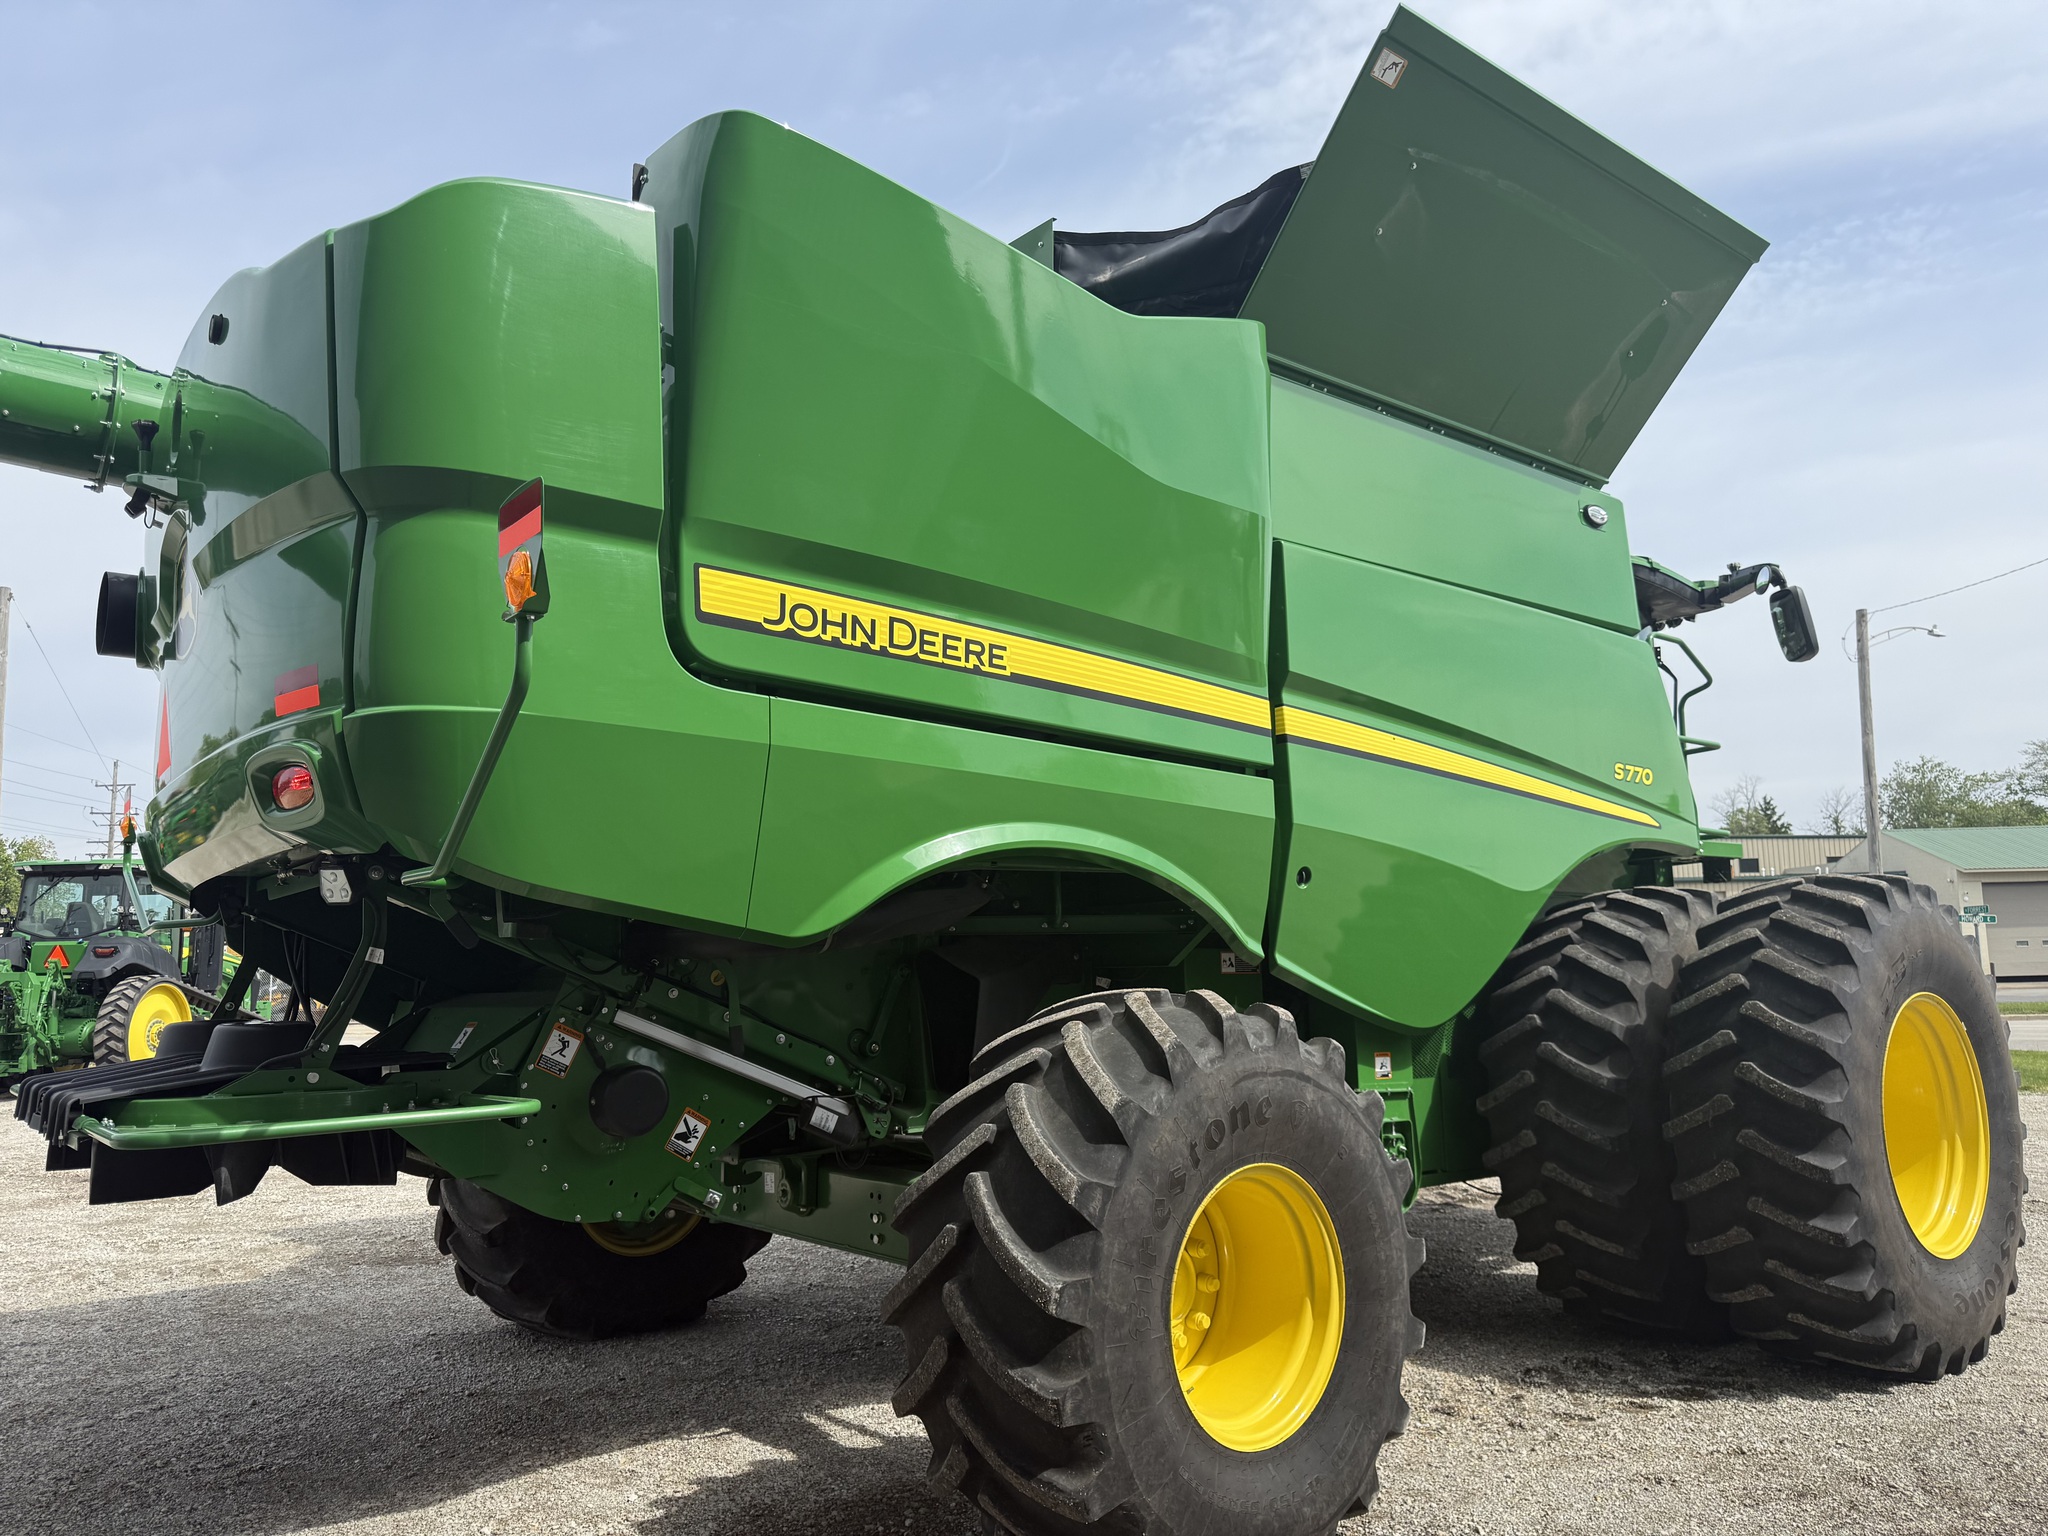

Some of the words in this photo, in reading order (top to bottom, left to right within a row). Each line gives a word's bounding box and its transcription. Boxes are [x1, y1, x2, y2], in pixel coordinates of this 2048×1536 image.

[762, 592, 877, 646] JOHN
[888, 615, 1009, 671] DEERE
[1614, 762, 1653, 786] S770
